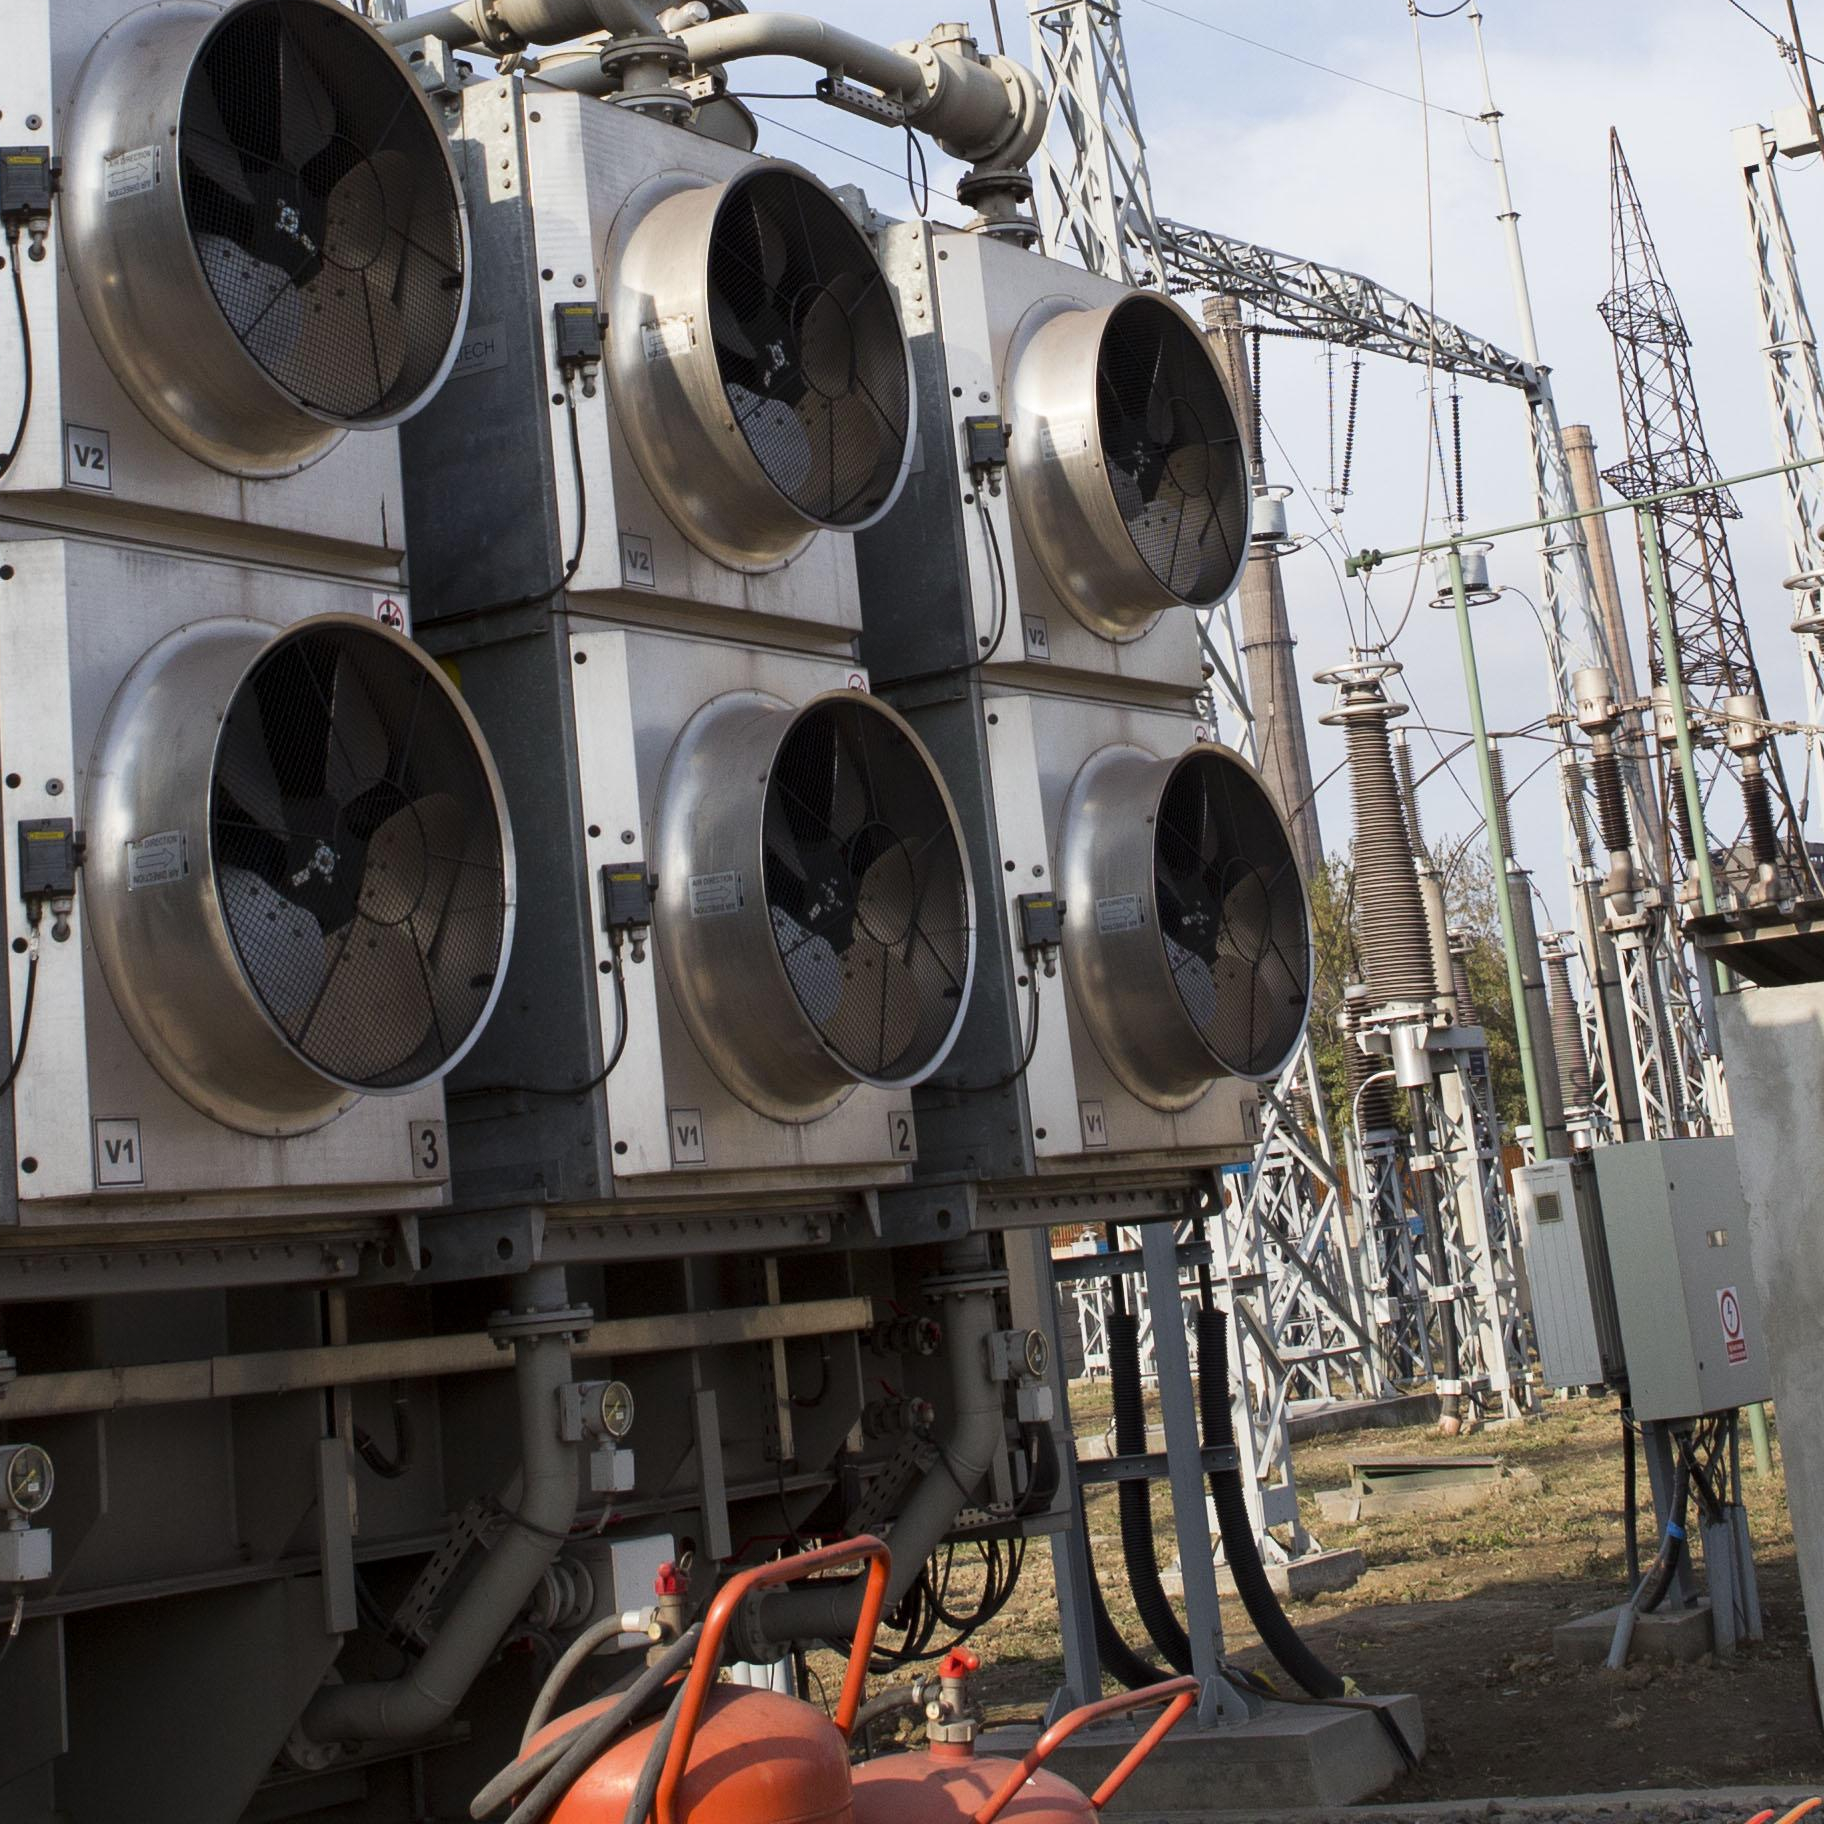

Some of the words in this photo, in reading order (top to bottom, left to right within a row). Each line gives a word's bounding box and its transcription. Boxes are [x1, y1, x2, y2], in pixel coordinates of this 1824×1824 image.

[74, 443, 105, 471] V2
[627, 549, 649, 571] V2
[1028, 627, 1046, 646] V2
[1086, 1114, 1102, 1133] V1
[1248, 1105, 1258, 1135] 1
[676, 1125, 699, 1147] V1
[896, 1118, 911, 1152] 2
[104, 1138, 135, 1164] V1
[421, 1128, 439, 1169] 3
